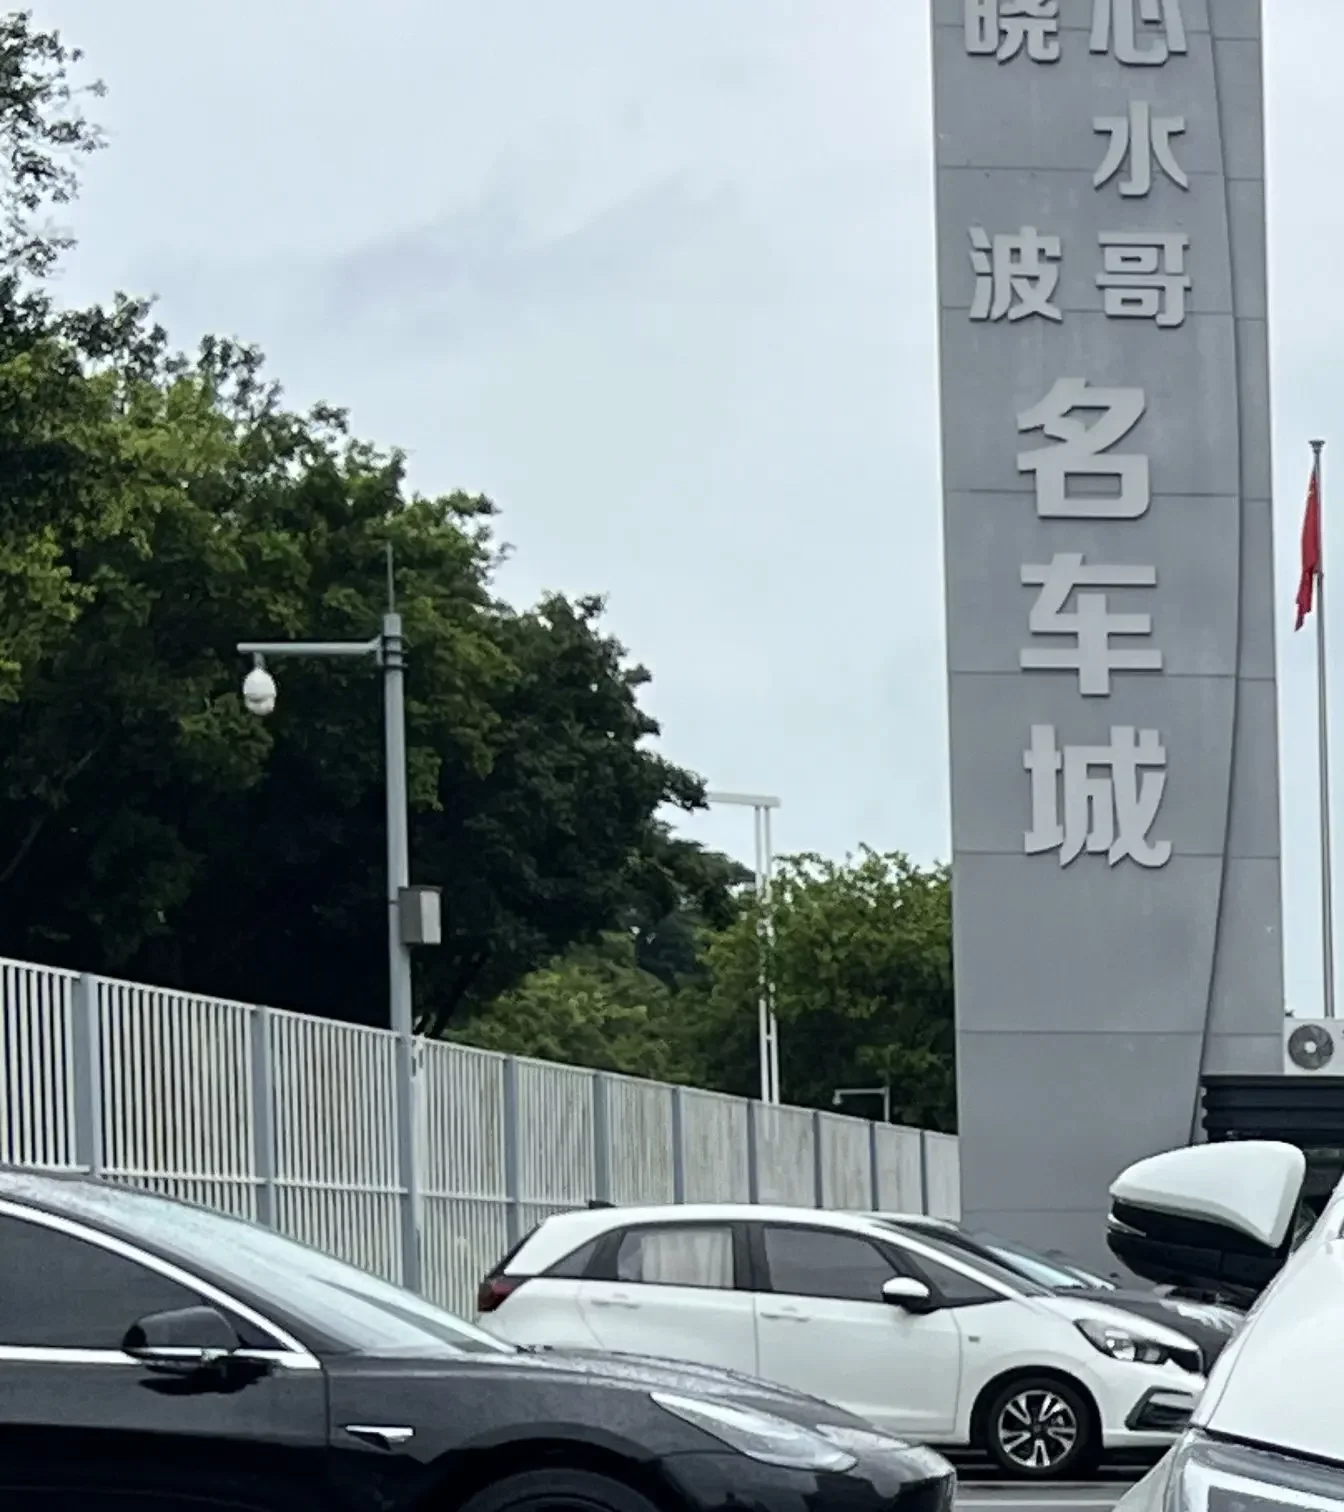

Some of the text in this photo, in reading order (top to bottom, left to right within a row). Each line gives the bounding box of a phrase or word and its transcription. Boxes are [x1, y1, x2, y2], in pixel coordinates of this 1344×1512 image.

[1089, 0, 1192, 328] 心水哥
[1017, 377, 1172, 869] 名车城
